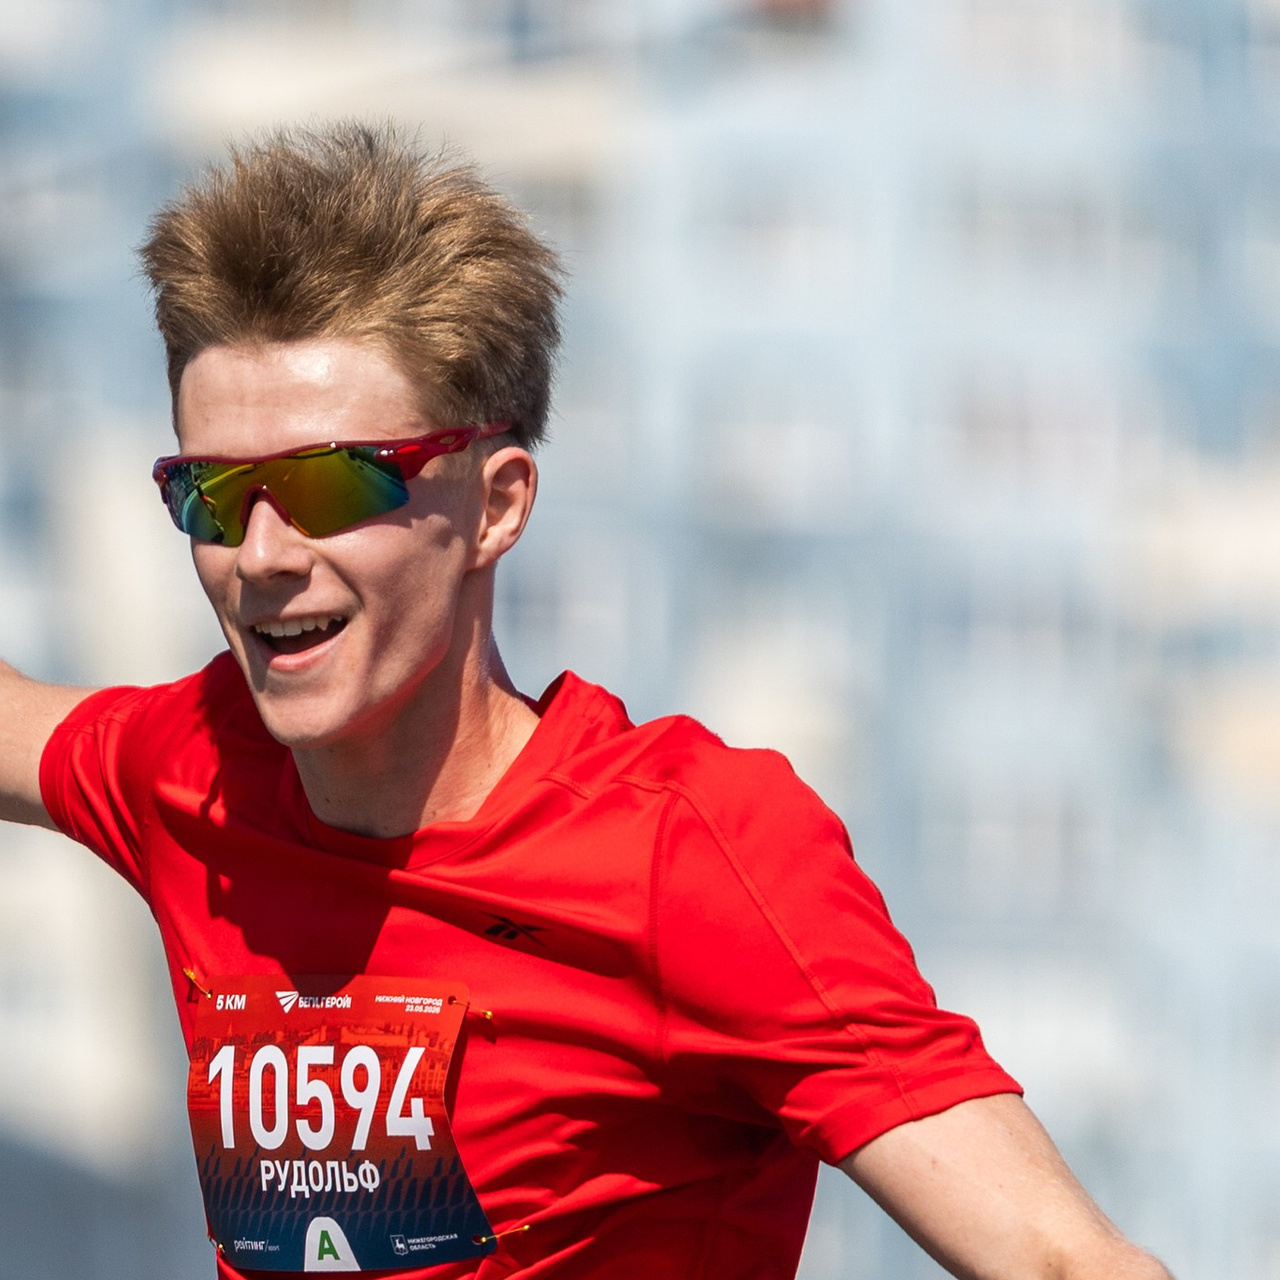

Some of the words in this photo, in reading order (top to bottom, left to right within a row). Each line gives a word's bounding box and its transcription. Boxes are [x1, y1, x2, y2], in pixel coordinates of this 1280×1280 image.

[215, 994, 224, 1010] 5
[375, 994, 405, 1003] НИЖНИЙ
[405, 996, 443, 1007] НОВГОРОД
[207, 1044, 435, 1151] 10594
[259, 1159, 381, 1199] РУДОЛЬФ
[407, 1233, 458, 1244] НИЖЕГОРОДСКАЯ
[409, 1243, 437, 1251] ОБЛАСТЬ
